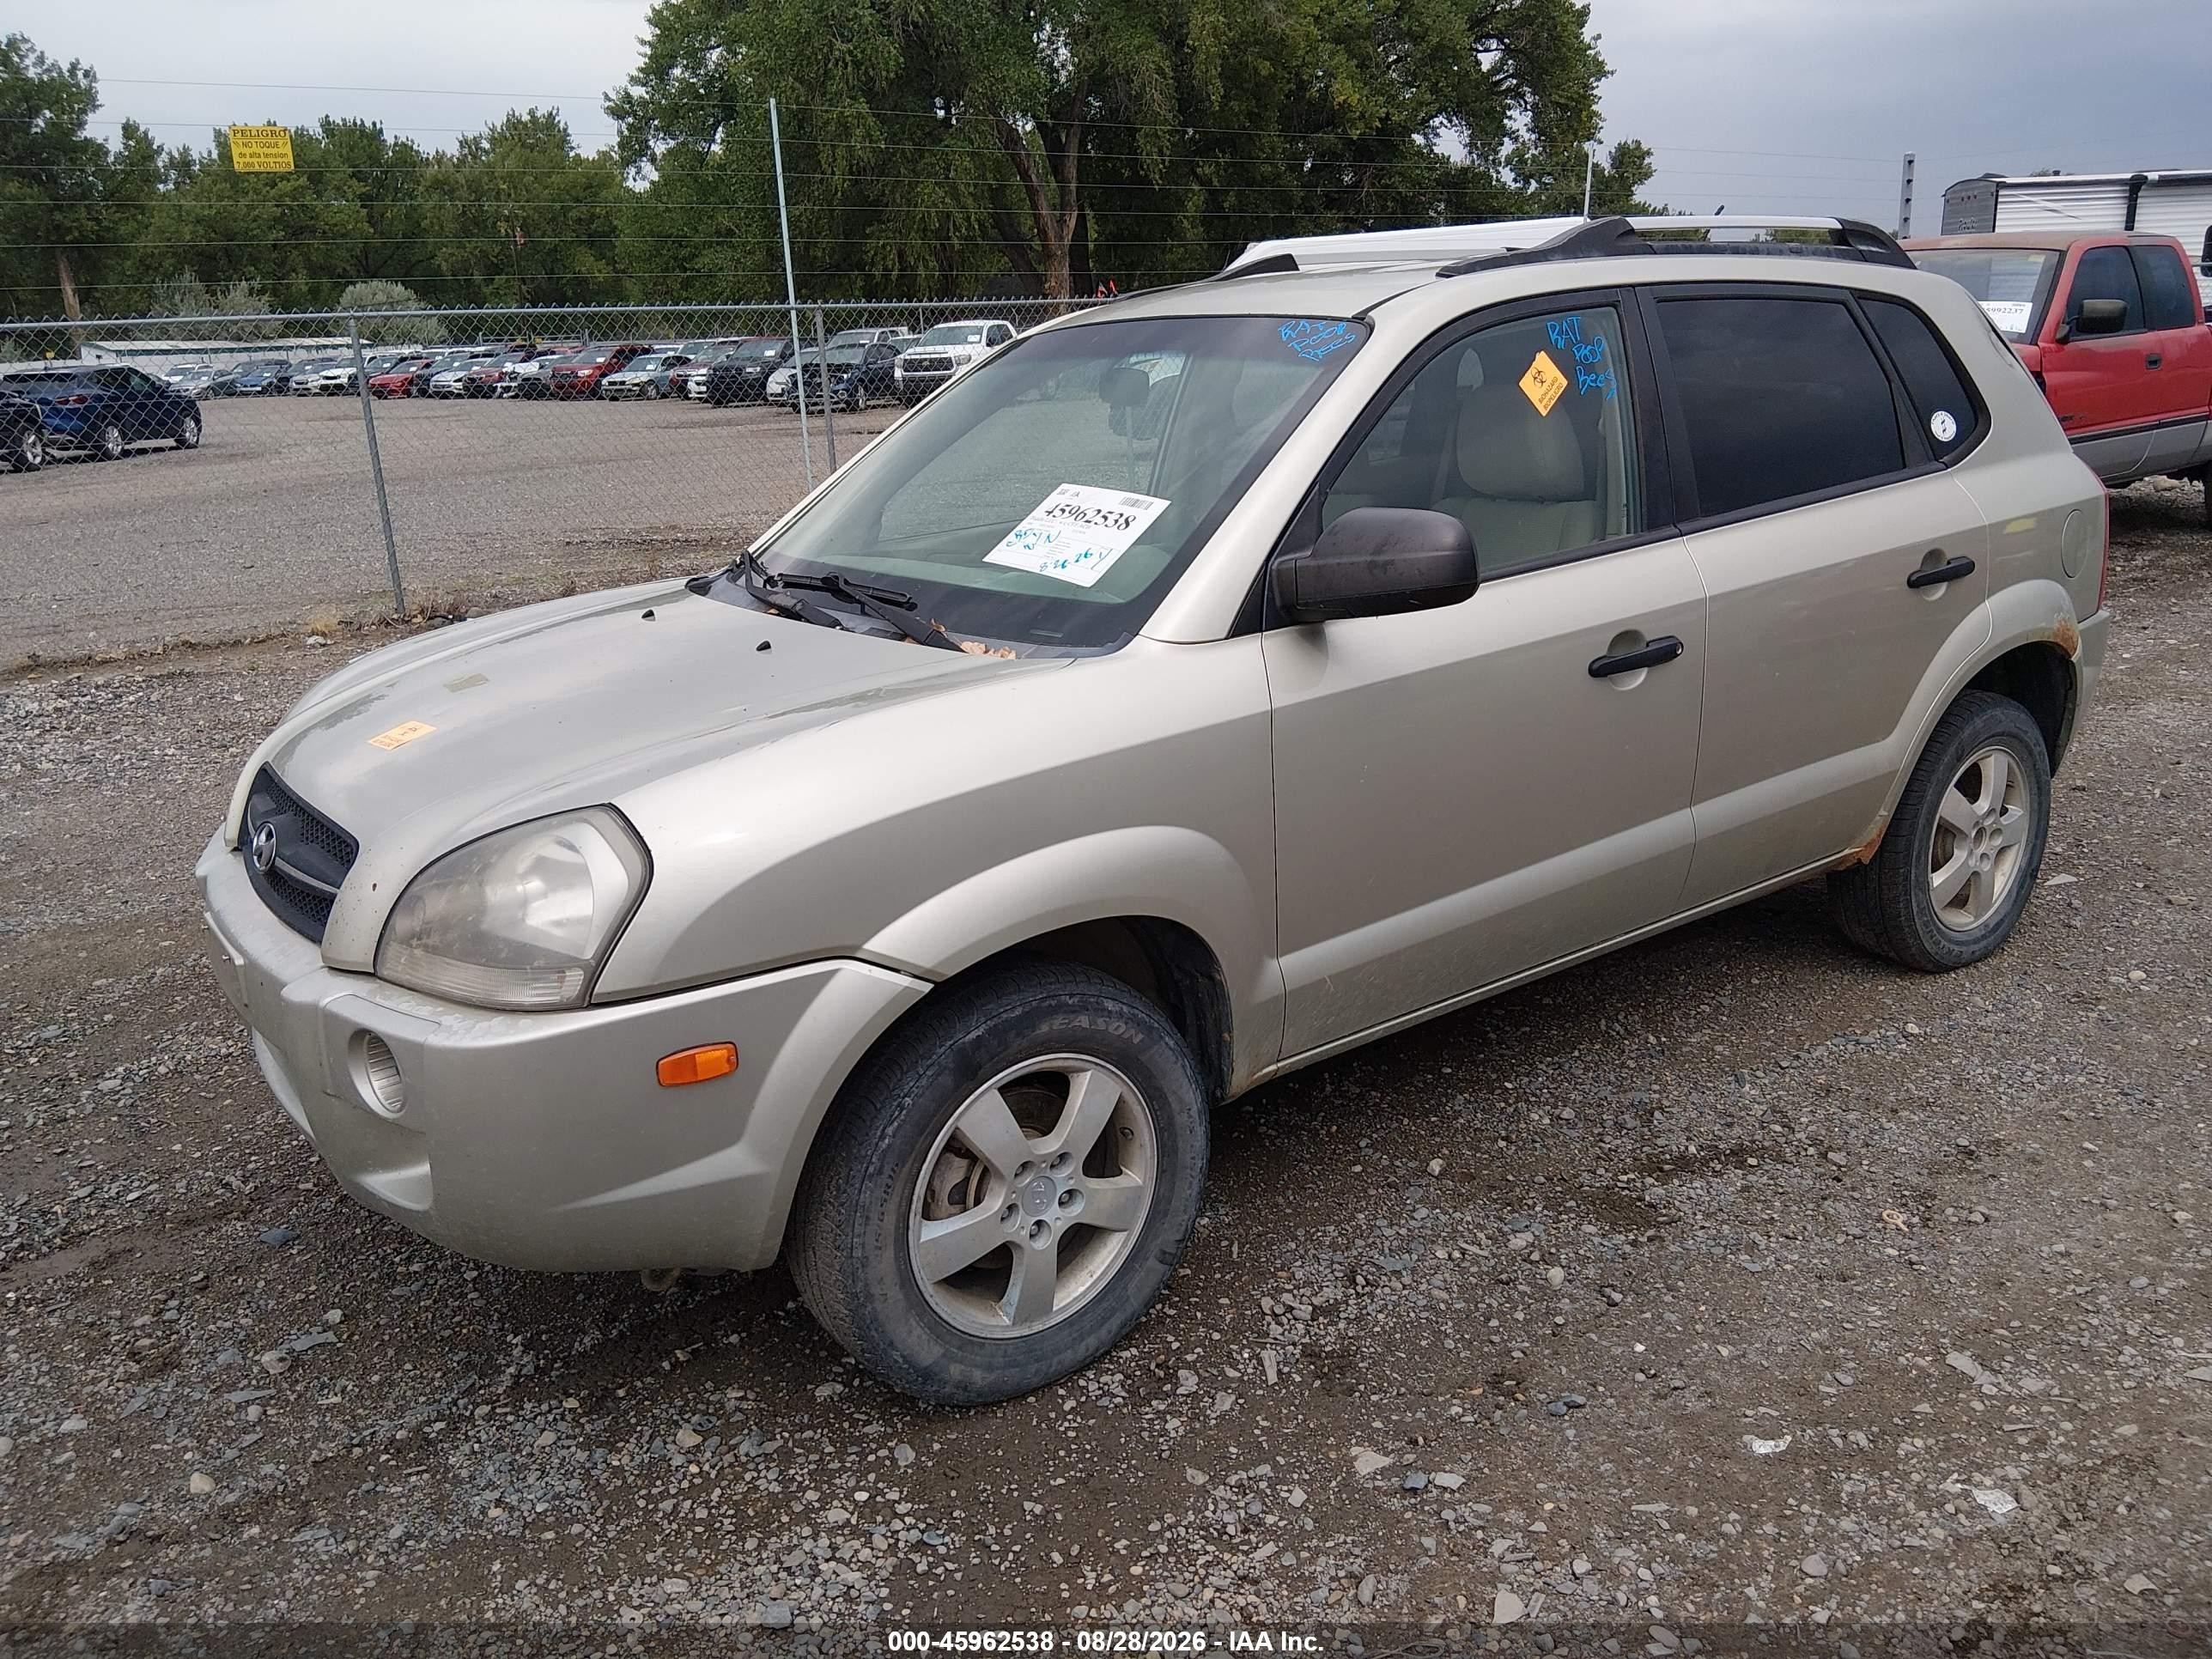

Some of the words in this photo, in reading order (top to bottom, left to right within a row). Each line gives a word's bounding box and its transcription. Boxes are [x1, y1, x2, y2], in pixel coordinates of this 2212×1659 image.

[232, 129, 288, 138] PELIGRO
[1546, 316, 1581, 349] RAT
[1539, 376, 1559, 404] BIOHAZARD
[1044, 501, 1137, 532] 45962538
